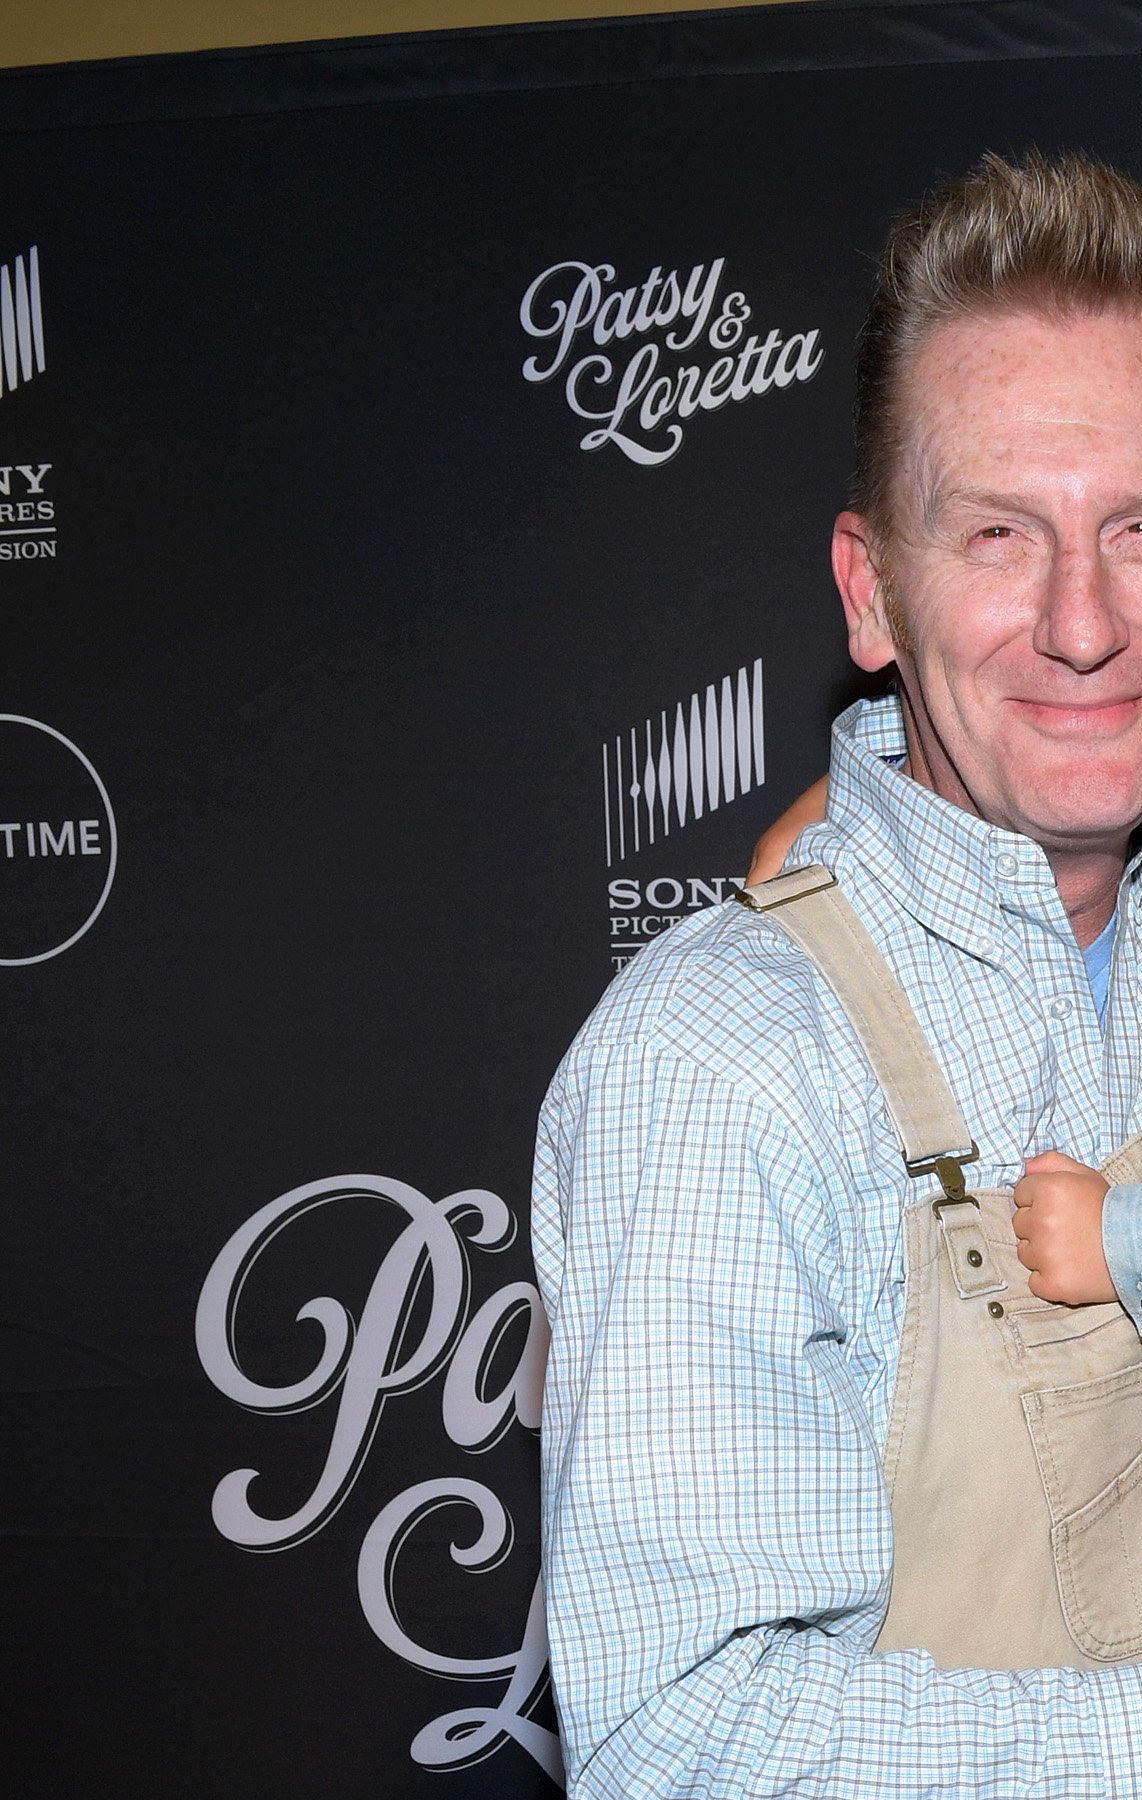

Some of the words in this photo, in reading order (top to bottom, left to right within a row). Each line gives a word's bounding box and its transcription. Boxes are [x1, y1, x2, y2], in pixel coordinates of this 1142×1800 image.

[519, 257, 726, 382] Patsy
[709, 292, 751, 350] &
[565, 343, 825, 467] Loretta
[0, 819, 102, 858] TIME
